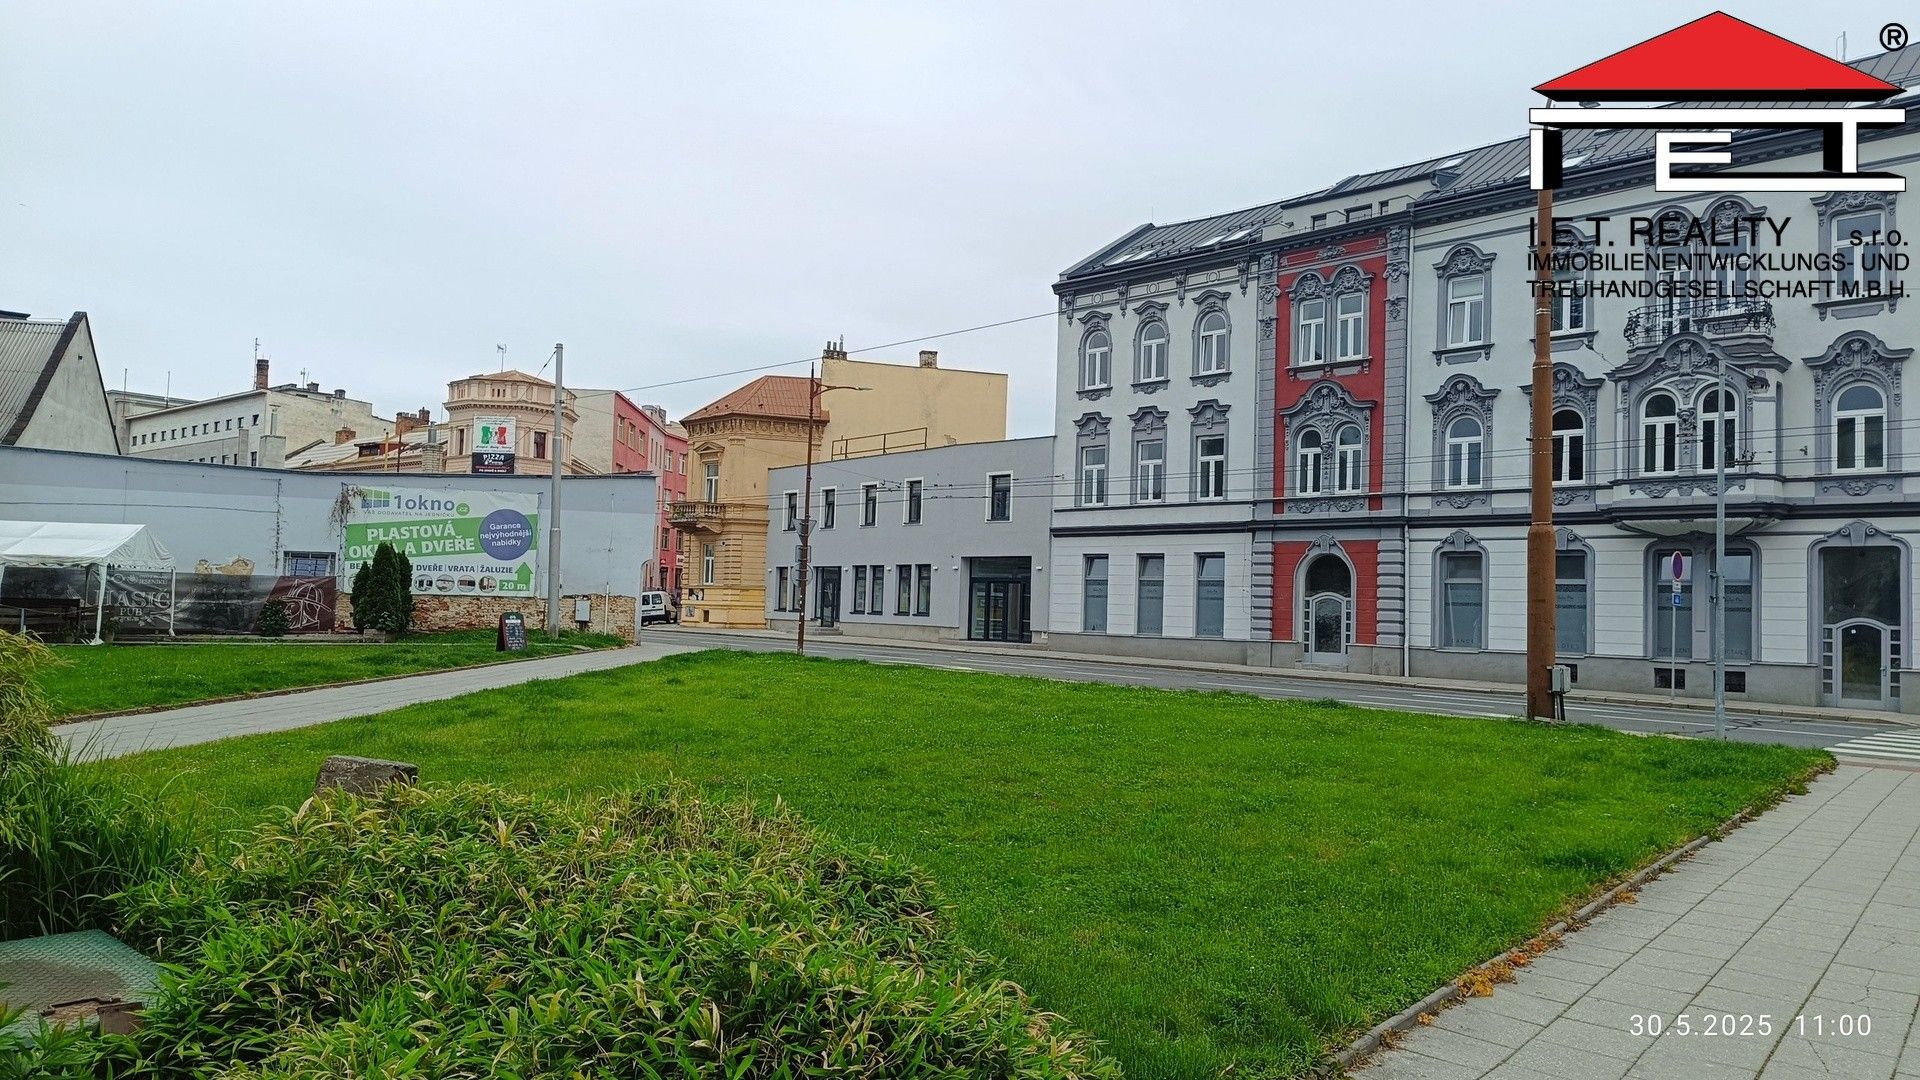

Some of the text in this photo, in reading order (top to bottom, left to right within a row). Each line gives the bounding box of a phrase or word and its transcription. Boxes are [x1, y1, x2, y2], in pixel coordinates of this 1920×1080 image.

[482, 453, 505, 461] PIZZA
[367, 520, 456, 541] PLASTOVÁ
[489, 523, 521, 531] Garance
[479, 529, 532, 540] nejvýhodnější
[403, 542, 417, 556] A
[421, 535, 476, 554] DVEŘE
[491, 538, 522, 547] nabídky
[416, 563, 443, 572] DVEŘE
[448, 565, 475, 573] VRATA
[480, 564, 513, 574] ŽALUZIE
[502, 581, 514, 590] 20
[120, 607, 143, 616] PUB
